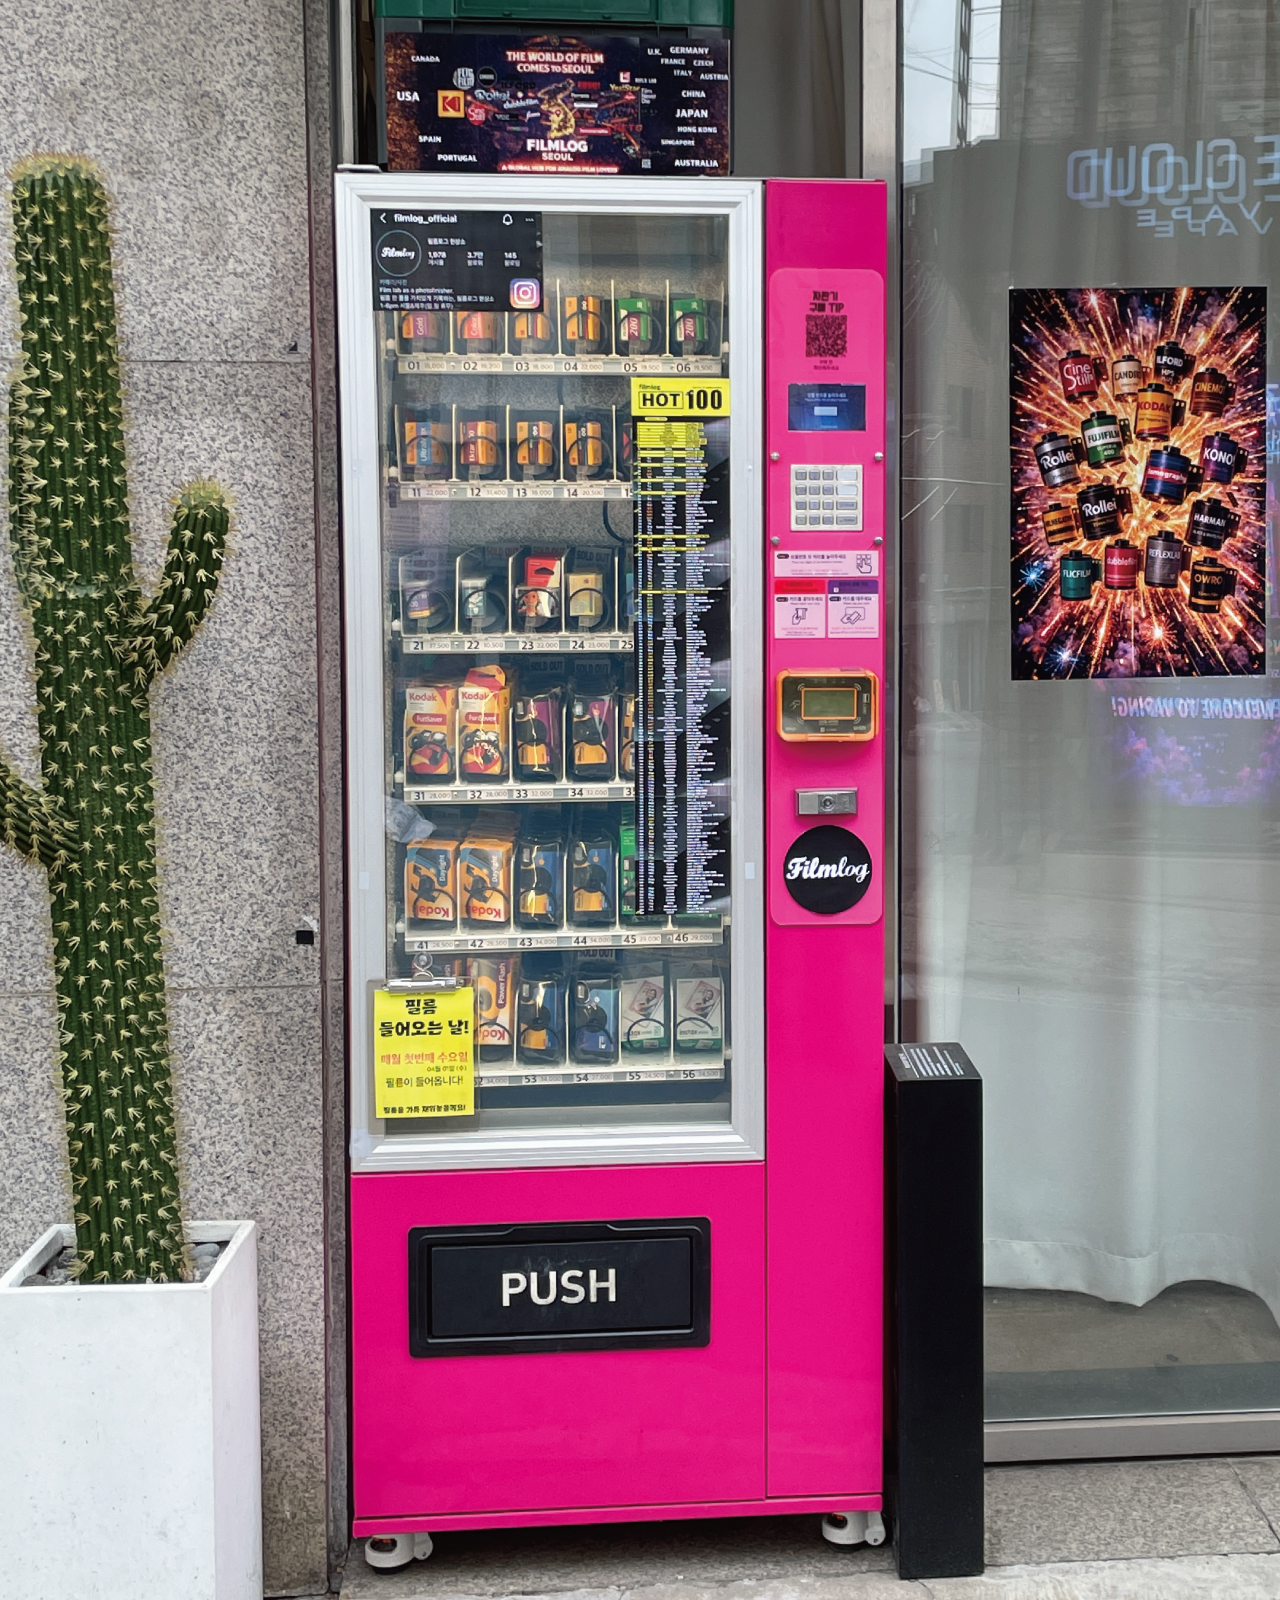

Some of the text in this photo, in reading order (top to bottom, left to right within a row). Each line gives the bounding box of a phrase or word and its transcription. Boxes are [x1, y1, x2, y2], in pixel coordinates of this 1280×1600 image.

[670, 46, 709, 55] GERMANY
[506, 52, 604, 63] THE WORLD OF FILM
[517, 64, 550, 73] COMES
[562, 64, 594, 74] SEOUL
[396, 91, 420, 102] USA
[675, 109, 708, 118] JAPAN
[526, 139, 588, 152] FILMLOG
[542, 152, 573, 161] SEOUL
[394, 214, 458, 224] filmlog_official
[381, 247, 415, 259] Filmlog
[813, 290, 838, 301] 자판기
[828, 302, 844, 313] TIP
[630, 317, 638, 336] 200
[686, 318, 694, 337] 200
[408, 361, 420, 370] 01
[464, 362, 477, 370] 02
[1156, 356, 1183, 367] ILFORD
[516, 362, 529, 371] 03
[564, 362, 578, 371] 04
[624, 363, 637, 372] 05
[676, 363, 690, 372] 06
[642, 389, 722, 410] HOT 100
[1138, 401, 1171, 413] KODAK
[1040, 449, 1075, 470] Rollei
[412, 488, 421, 497] 11
[471, 488, 481, 496] 12
[517, 488, 527, 497] 13
[567, 489, 578, 497] 14
[1082, 498, 1117, 517] Rollei
[1194, 513, 1226, 527] HARMAN
[577, 550, 610, 562] SOLD OUT
[1062, 569, 1091, 578] FLICFILM
[414, 641, 424, 650] 21
[467, 641, 480, 649] 22
[522, 641, 534, 650] 23
[572, 641, 585, 650] 24
[621, 640, 633, 649] 25
[409, 693, 437, 702] Kodak
[462, 692, 490, 701] Kodak
[414, 792, 425, 800] 31
[470, 790, 482, 799] 32
[516, 789, 528, 798] 33
[570, 788, 583, 797] 34
[786, 856, 870, 883] Filmlog
[519, 938, 532, 946] 43
[574, 937, 587, 945] 44
[624, 935, 637, 943] 45
[675, 933, 689, 942] 46
[417, 941, 428, 949] 41
[470, 939, 484, 948] 42
[406, 999, 437, 1015] 필름
[379, 1019, 469, 1037] 들어오는 날!
[380, 1051, 468, 1065] 매월 첫번째 수요일
[576, 1074, 589, 1082] 54
[628, 1072, 641, 1080] 55
[682, 1070, 695, 1078] 56
[386, 1075, 463, 1088] 필름이 들어옵니다!
[524, 1075, 537, 1083] 53
[502, 1268, 616, 1307] PUSH
